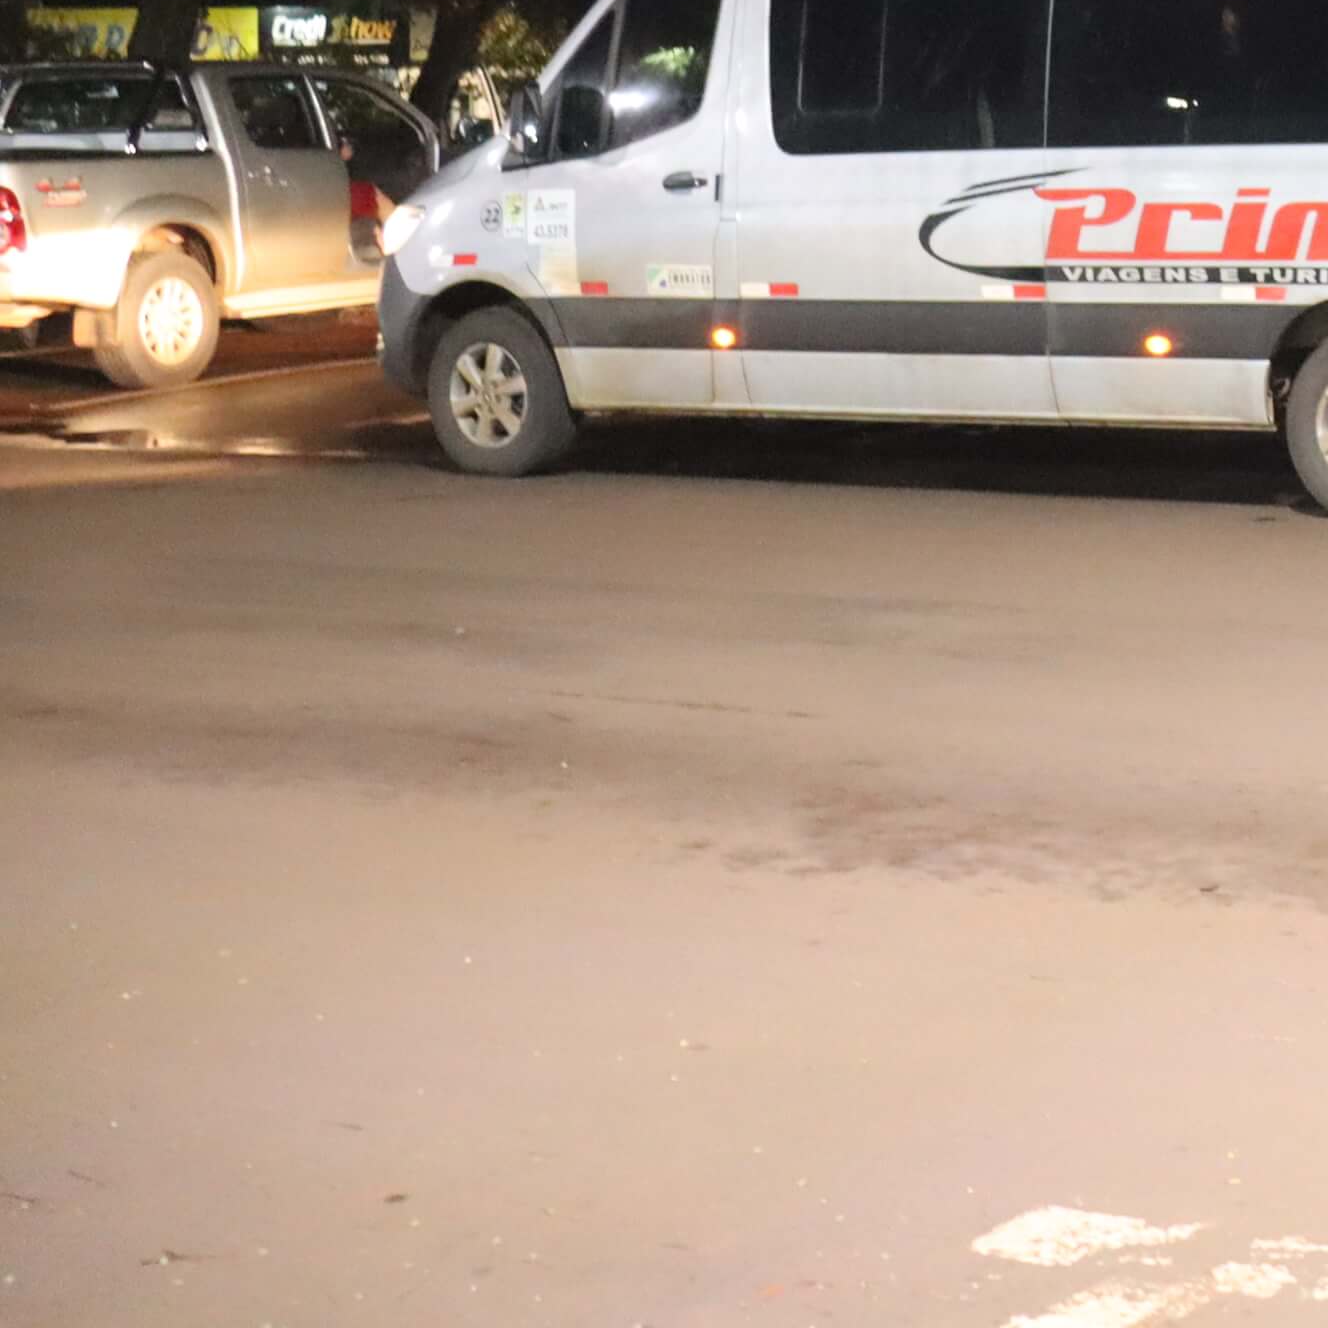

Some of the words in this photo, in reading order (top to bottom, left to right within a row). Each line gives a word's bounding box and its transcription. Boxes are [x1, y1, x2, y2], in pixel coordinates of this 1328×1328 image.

[484, 207, 500, 224] 22
[1061, 267, 1208, 282] VIAGENS
[1220, 267, 1239, 283] E
